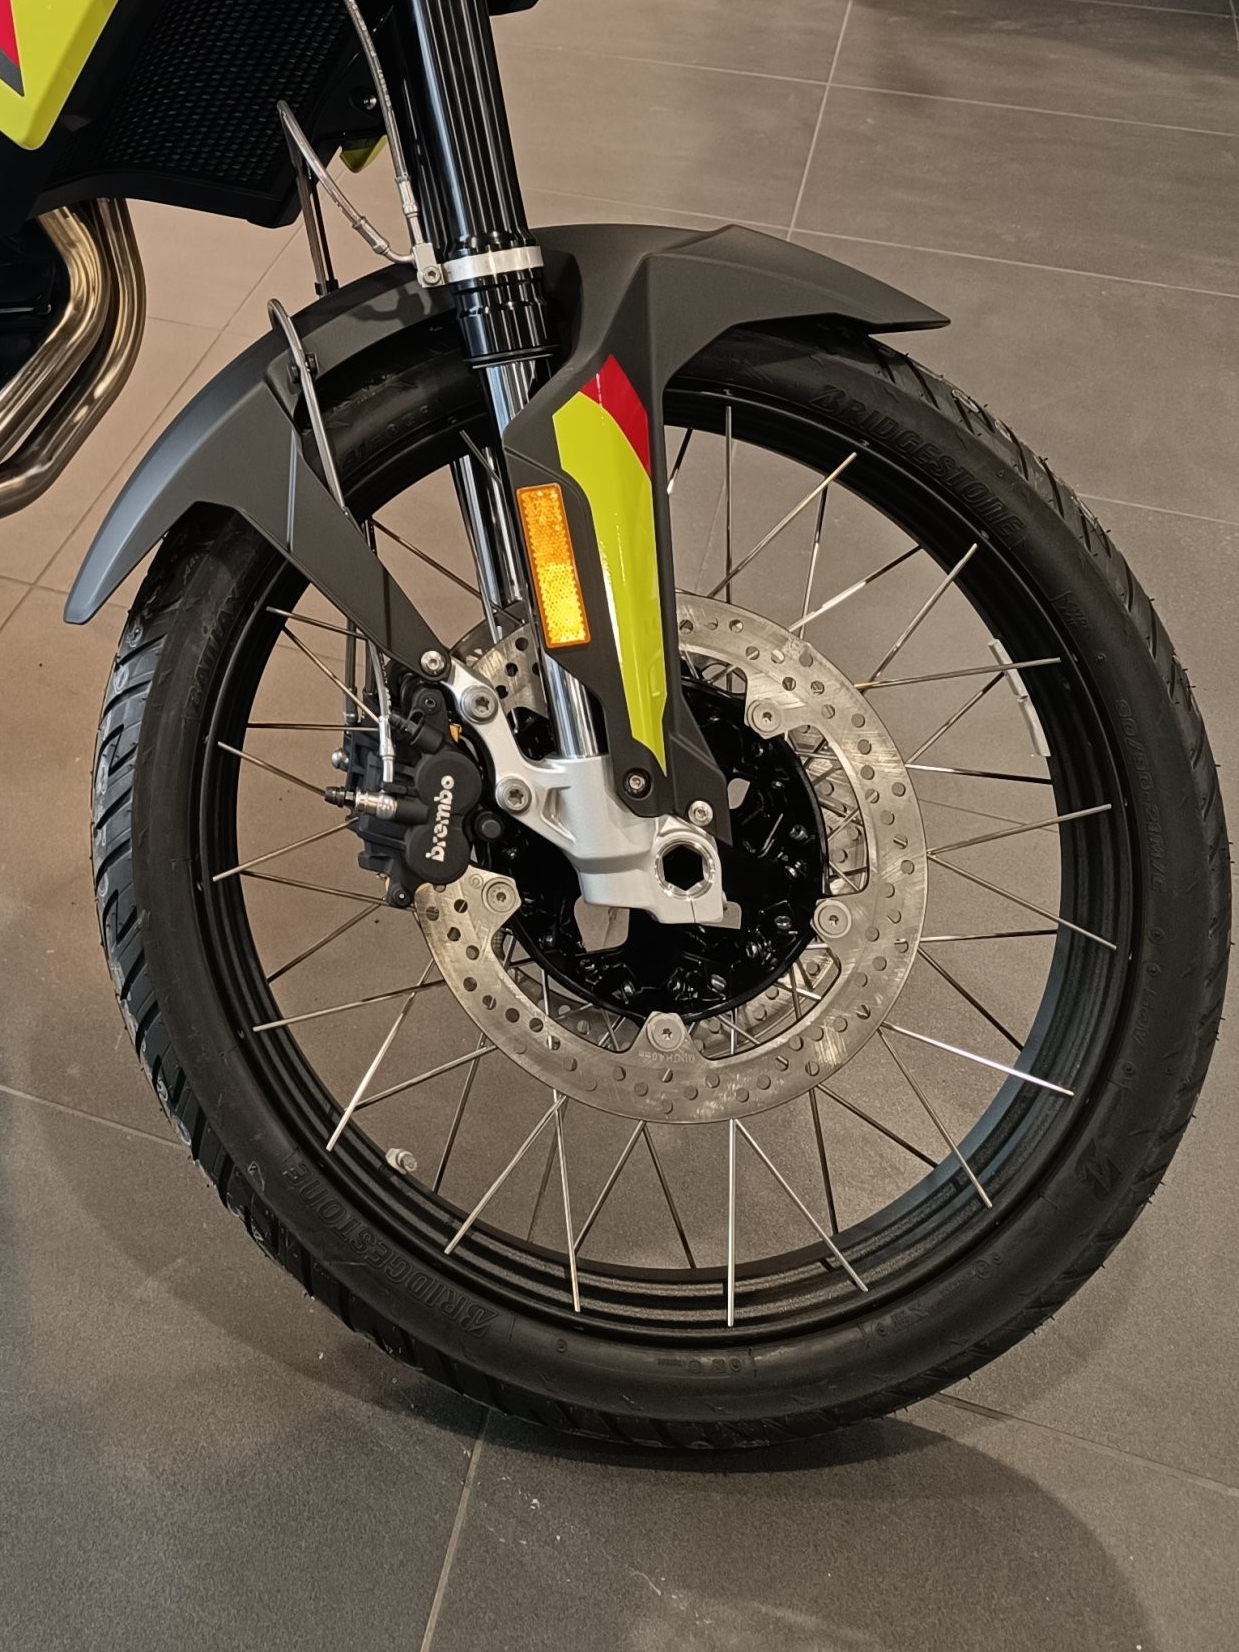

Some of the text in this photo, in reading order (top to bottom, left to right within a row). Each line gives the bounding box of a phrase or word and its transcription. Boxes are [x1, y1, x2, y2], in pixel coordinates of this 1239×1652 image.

[809, 385, 1027, 539] BRIDGESTONE
[425, 775, 455, 862] brembo
[281, 1162, 499, 1336] BRIDGESTONE
